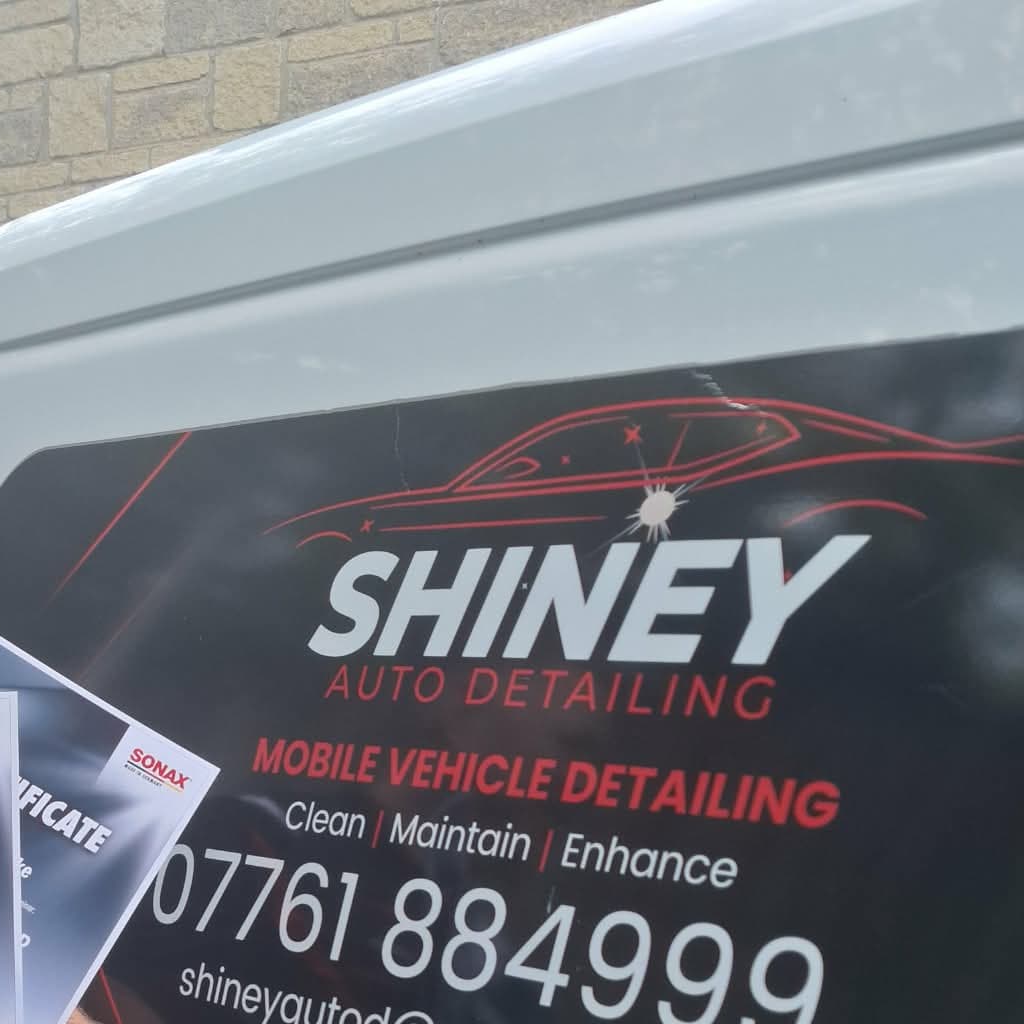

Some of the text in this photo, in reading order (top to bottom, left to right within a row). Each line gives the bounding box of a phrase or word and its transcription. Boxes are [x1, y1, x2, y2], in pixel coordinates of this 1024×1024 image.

[308, 534, 871, 667] SHINEY
[324, 666, 777, 721] AUTO DETAILING
[130, 748, 189, 790] SONAX
[253, 737, 841, 830] MOBILE VEHICLE DETAILING
[284, 800, 739, 890] Clean Maintain Enhance
[151, 844, 359, 962] 07761
